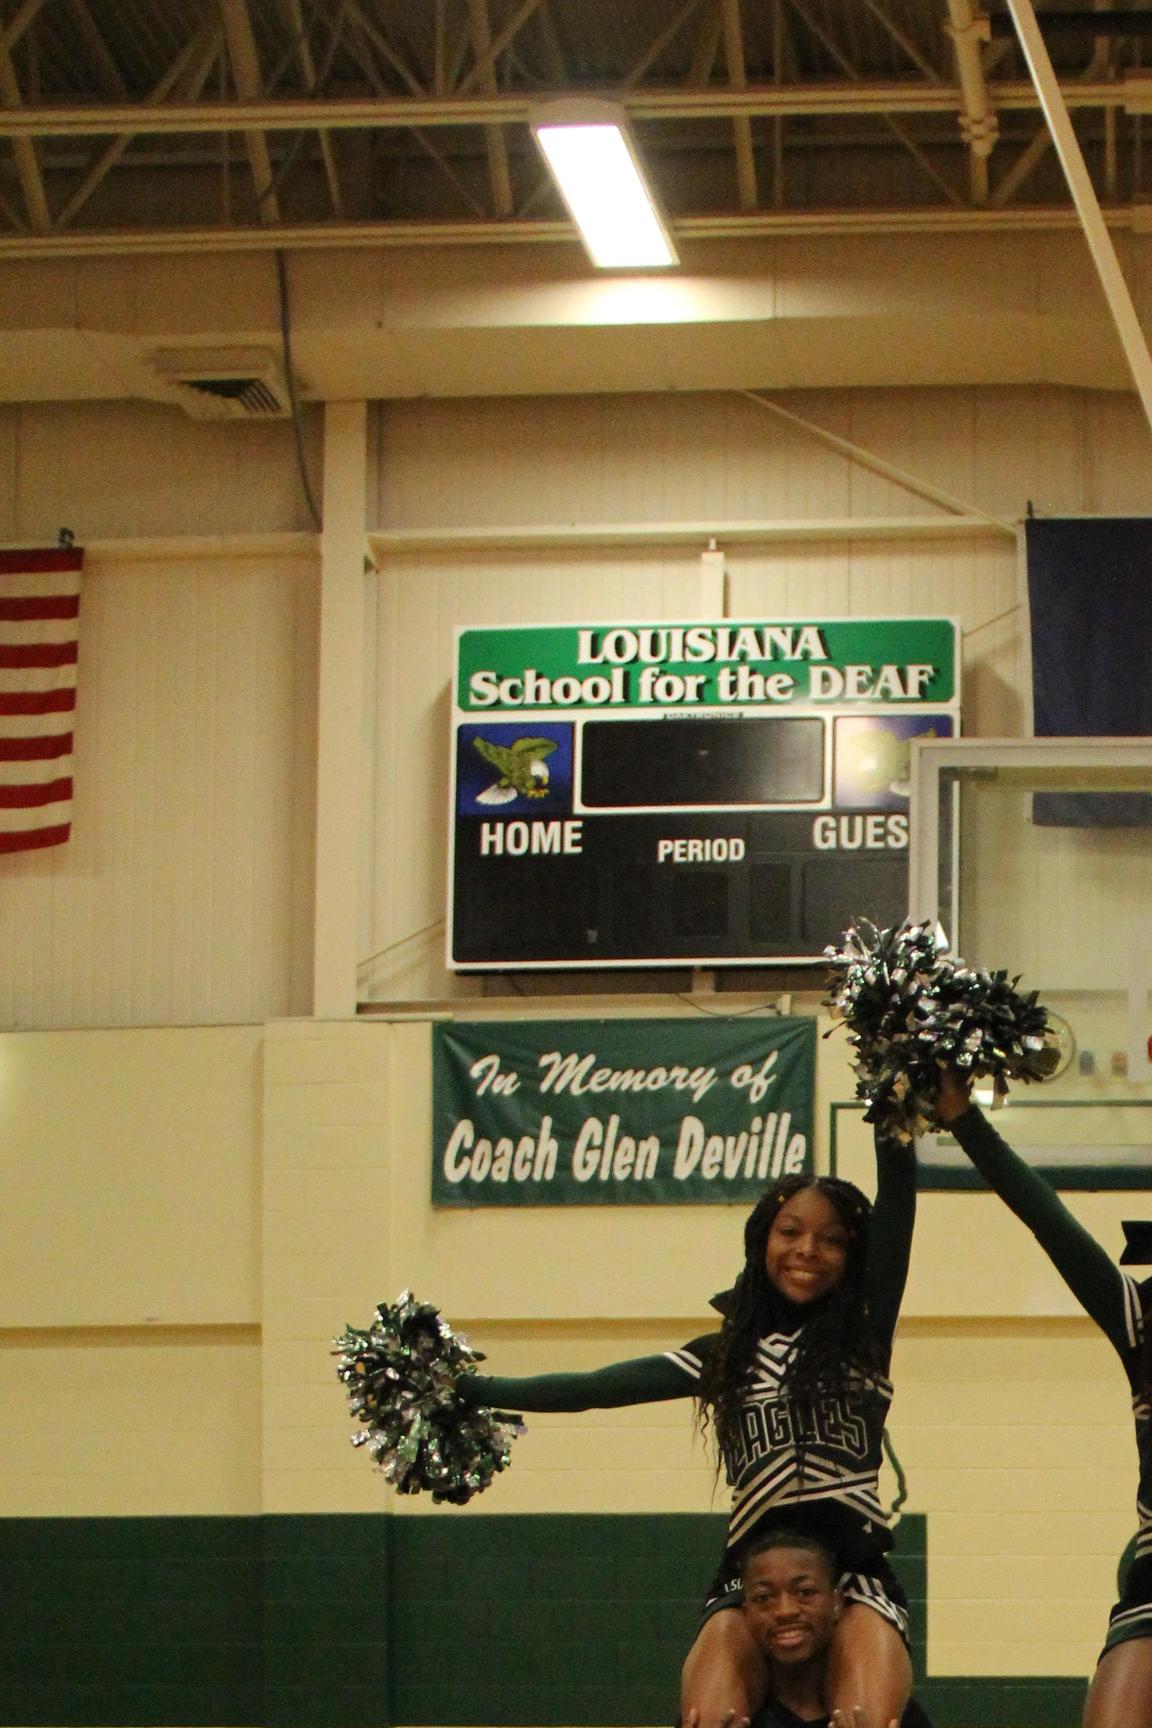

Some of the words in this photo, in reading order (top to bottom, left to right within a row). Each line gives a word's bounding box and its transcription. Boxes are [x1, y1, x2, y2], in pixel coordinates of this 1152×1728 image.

[577, 626, 829, 664] LOUISIANA
[469, 669, 626, 706] School
[639, 667, 706, 702] for
[718, 667, 794, 700] the
[808, 664, 936, 700] DEAF
[480, 820, 583, 855] HOME
[657, 838, 746, 862] PERIOD
[813, 815, 909, 850] GUES
[470, 1054, 520, 1097] In
[539, 1051, 718, 1102] Memory
[730, 1050, 780, 1103] of
[443, 1115, 558, 1184] Coach
[572, 1113, 660, 1182] Glen
[673, 1111, 807, 1182] Deville
